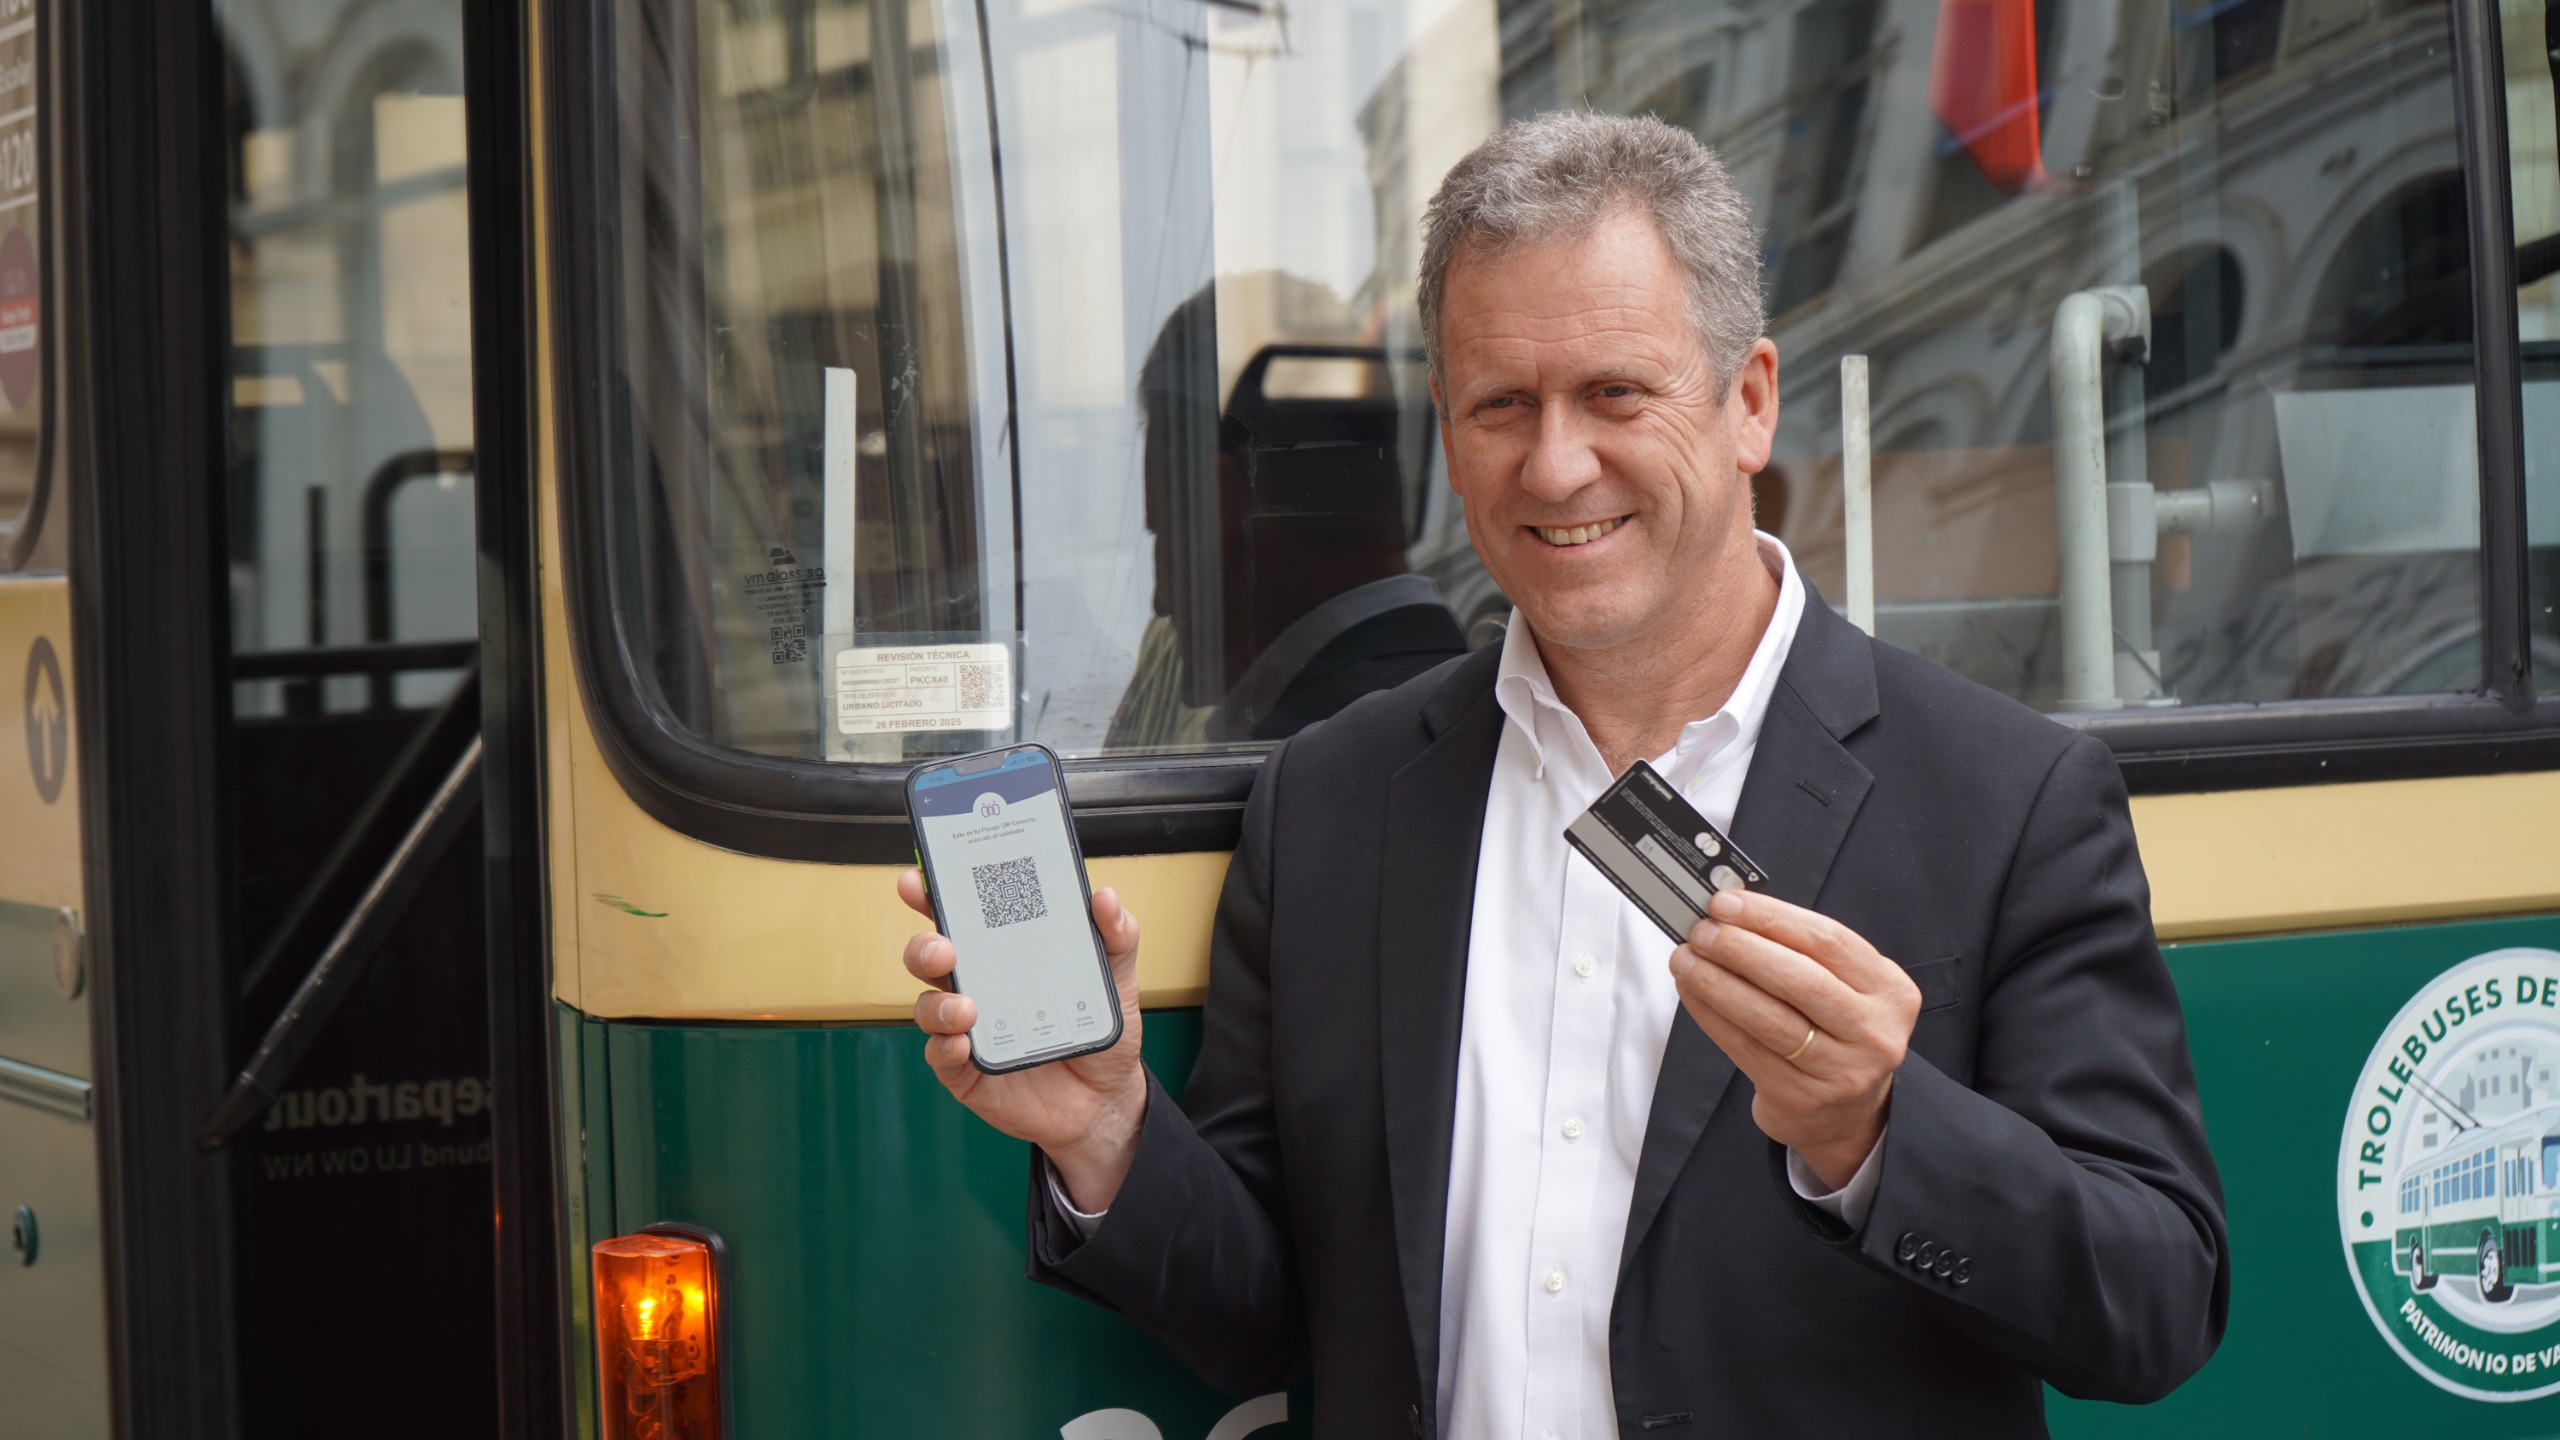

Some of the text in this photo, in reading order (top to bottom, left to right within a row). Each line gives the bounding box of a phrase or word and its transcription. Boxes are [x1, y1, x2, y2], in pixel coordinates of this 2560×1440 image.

[0, 128, 33, 193] 120
[877, 650, 970, 663] REVISIÓN TÉCNICA
[849, 668, 884, 676] DISTINTIVO
[910, 675, 949, 685] PKCX40
[858, 692, 867, 700] DE
[868, 691, 898, 699] SERVICIO
[842, 700, 923, 711] URBANO LICITADO
[875, 720, 887, 730] 26
[889, 719, 937, 729] FEBRERO
[940, 717, 962, 727] 2025
[952, 832, 965, 840] Este
[981, 823, 1000, 834] Pasaje
[2358, 975, 2559, 1190] TROLEBUSES DE
[2512, 1352, 2537, 1375] DE
